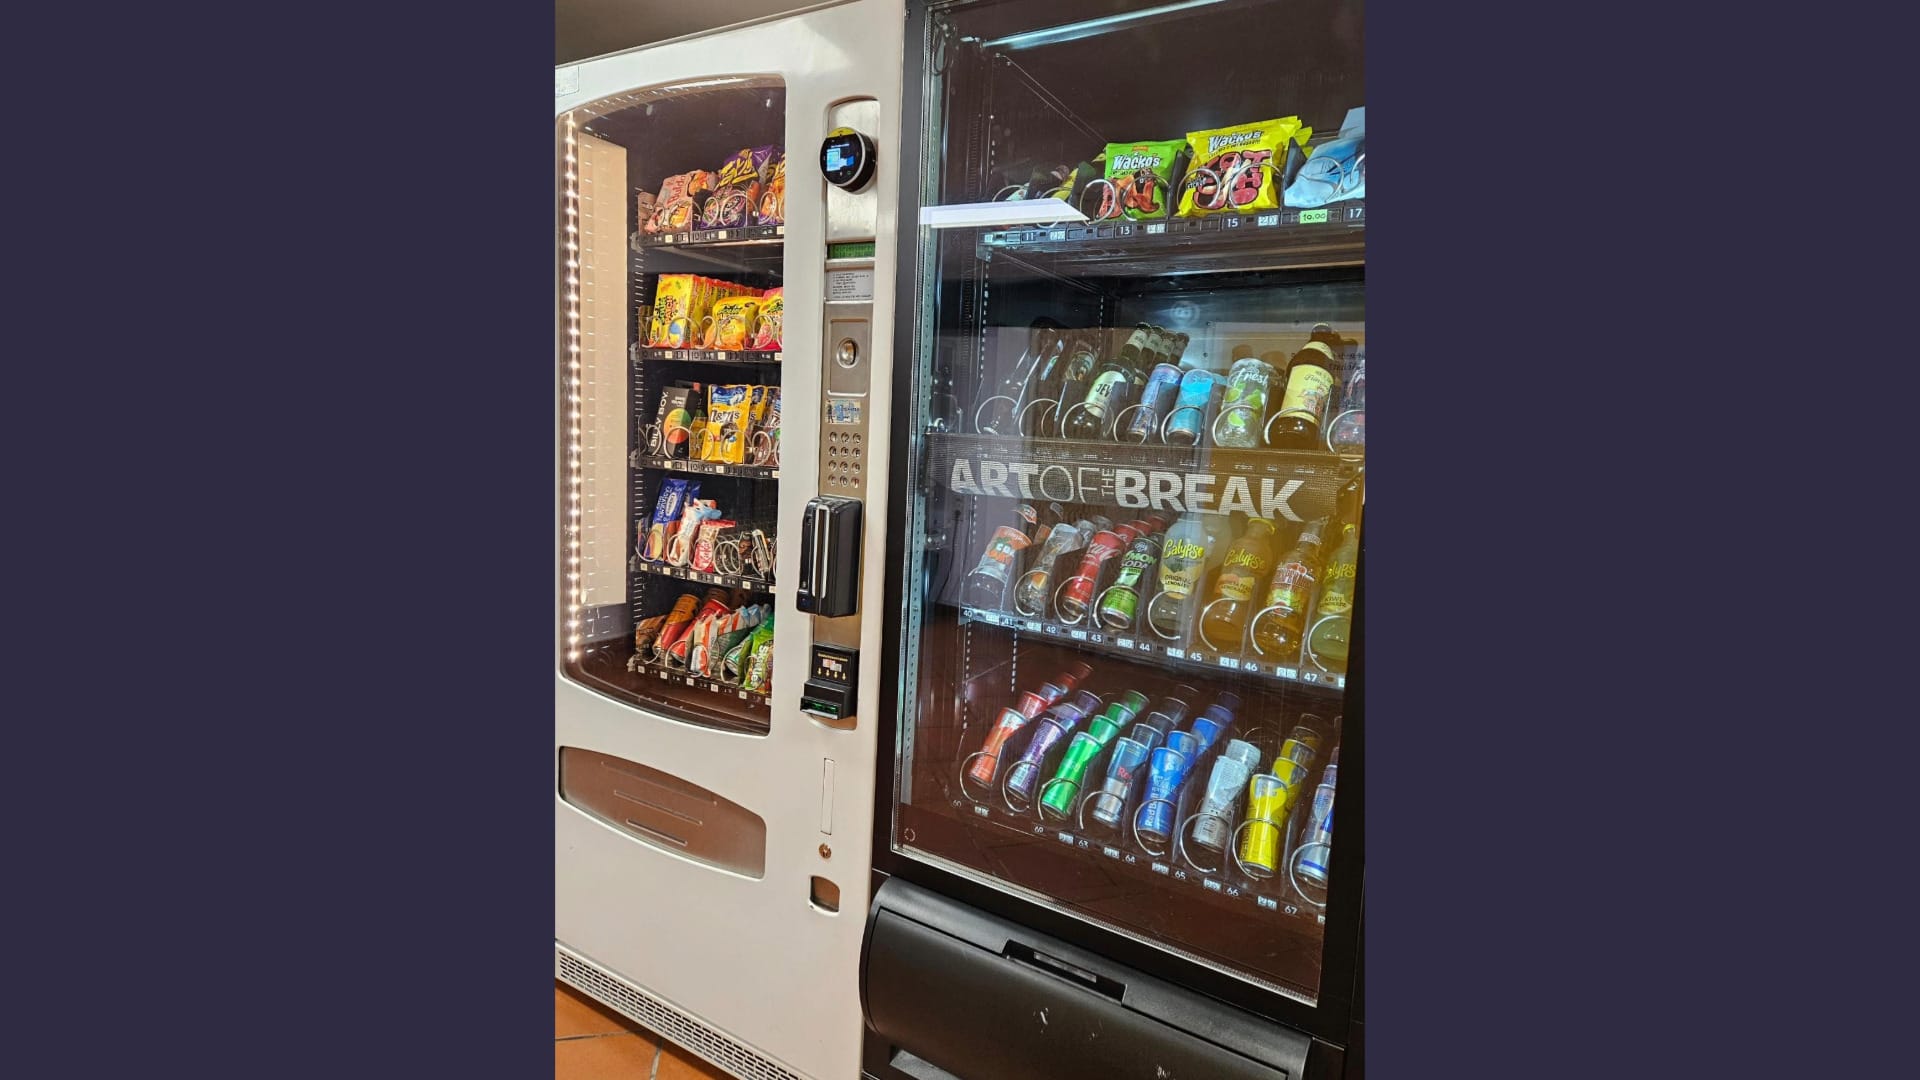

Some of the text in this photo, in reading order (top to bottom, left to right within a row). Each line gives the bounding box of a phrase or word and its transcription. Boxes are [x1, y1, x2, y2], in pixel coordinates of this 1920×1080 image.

[1349, 208, 1363, 219] 17
[1227, 218, 1239, 228] 15
[1120, 226, 1131, 235] 13
[951, 459, 1305, 522] ART OF THE BREAK
[1164, 539, 1204, 560] Calypso
[1046, 625, 1056, 634] 42
[1091, 634, 1101, 642] 43
[1139, 643, 1150, 651] 44
[1190, 653, 1202, 662] 45
[1244, 662, 1258, 672] 46
[1304, 673, 1318, 682] 47
[1125, 854, 1135, 863] 64
[1174, 870, 1186, 880] 65
[1227, 887, 1239, 897] 66
[1284, 905, 1298, 915] 67
